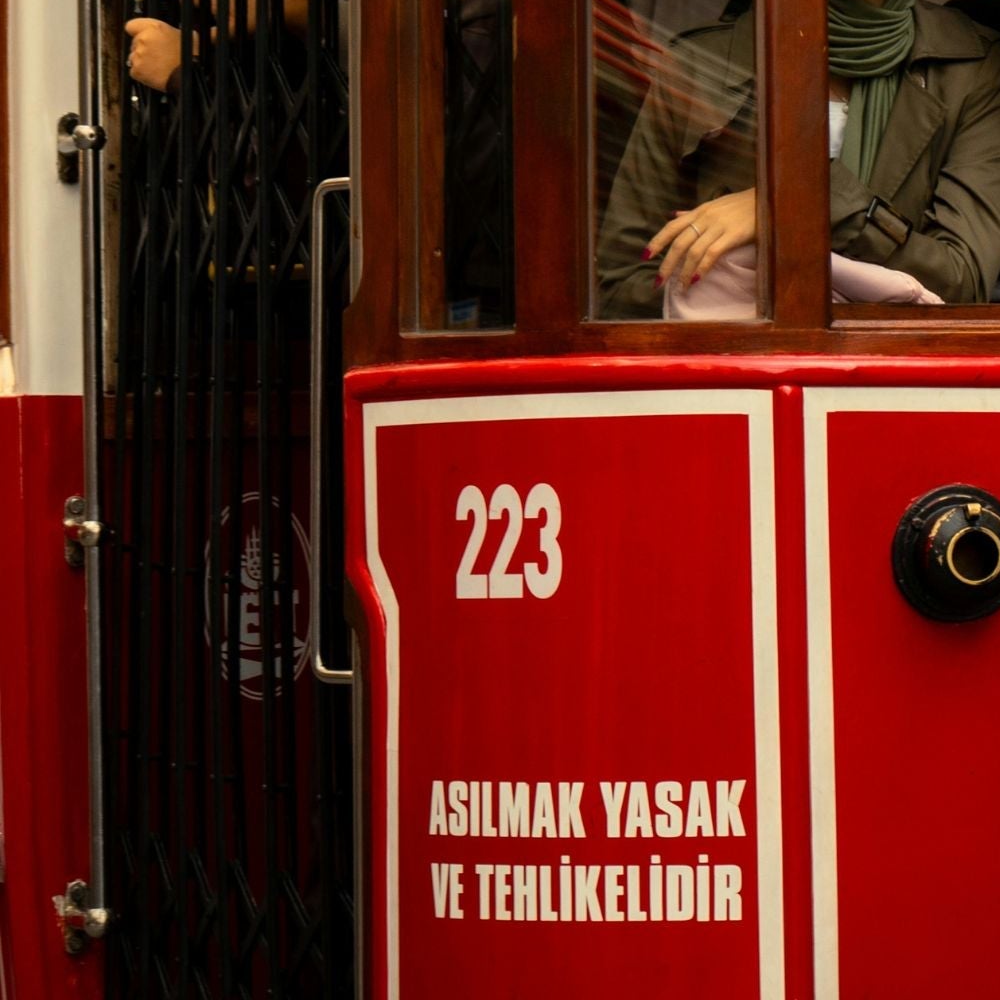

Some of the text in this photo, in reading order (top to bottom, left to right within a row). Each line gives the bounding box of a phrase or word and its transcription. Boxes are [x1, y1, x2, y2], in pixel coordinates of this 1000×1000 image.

[456, 482, 562, 599] 223
[429, 779, 746, 838] ASILMAK YASAK
[431, 854, 742, 922] VE TEHLİKELİDİR
